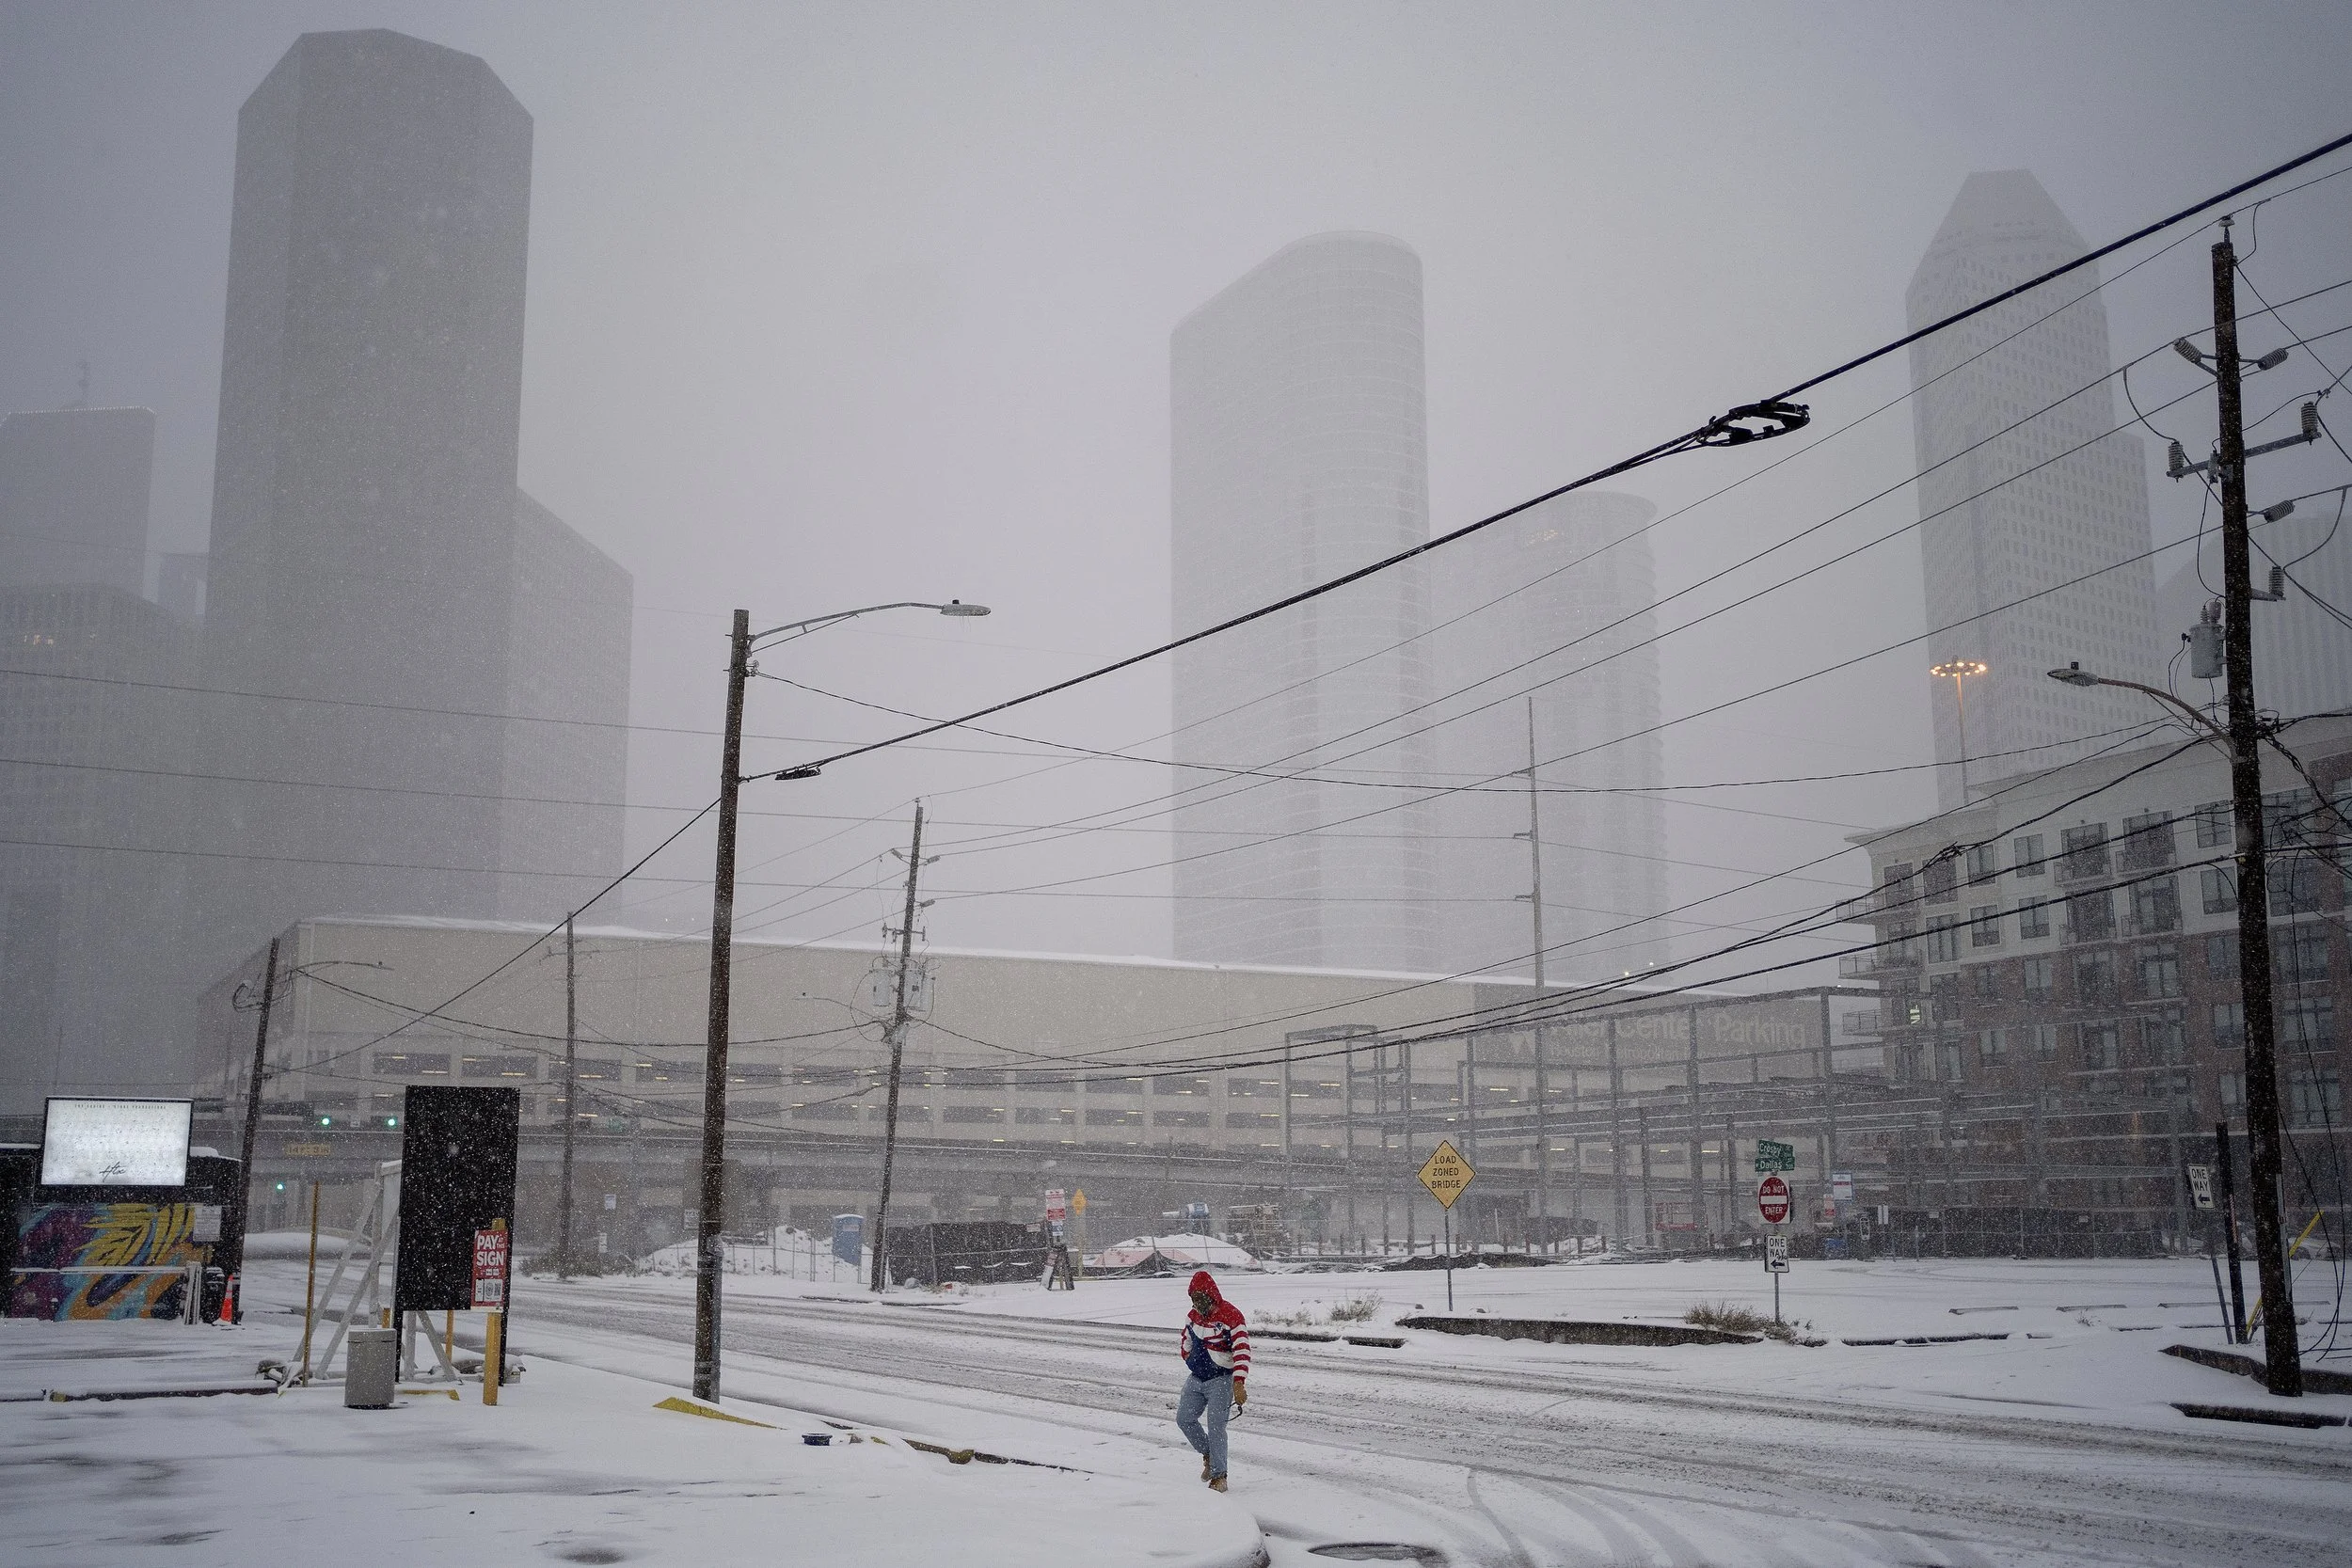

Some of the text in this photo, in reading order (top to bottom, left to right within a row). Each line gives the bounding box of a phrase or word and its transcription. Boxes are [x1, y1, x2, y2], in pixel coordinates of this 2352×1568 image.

[1614, 1012, 1692, 1039] Cente
[1435, 1155, 1456, 1164] LOAD
[1759, 1160, 1783, 1169] Dallas
[2192, 1168, 2207, 1179] ONE
[1432, 1180, 1461, 1189] BRIDGE
[1763, 1185, 1771, 1194] DO
[2193, 1180, 2208, 1191] WAY
[1765, 1206, 1783, 1214] ENTER
[477, 1234, 499, 1250] PAY
[1770, 1237, 1785, 1247] ONE
[1770, 1248, 1786, 1258] WAY
[476, 1251, 504, 1266] SIGN
